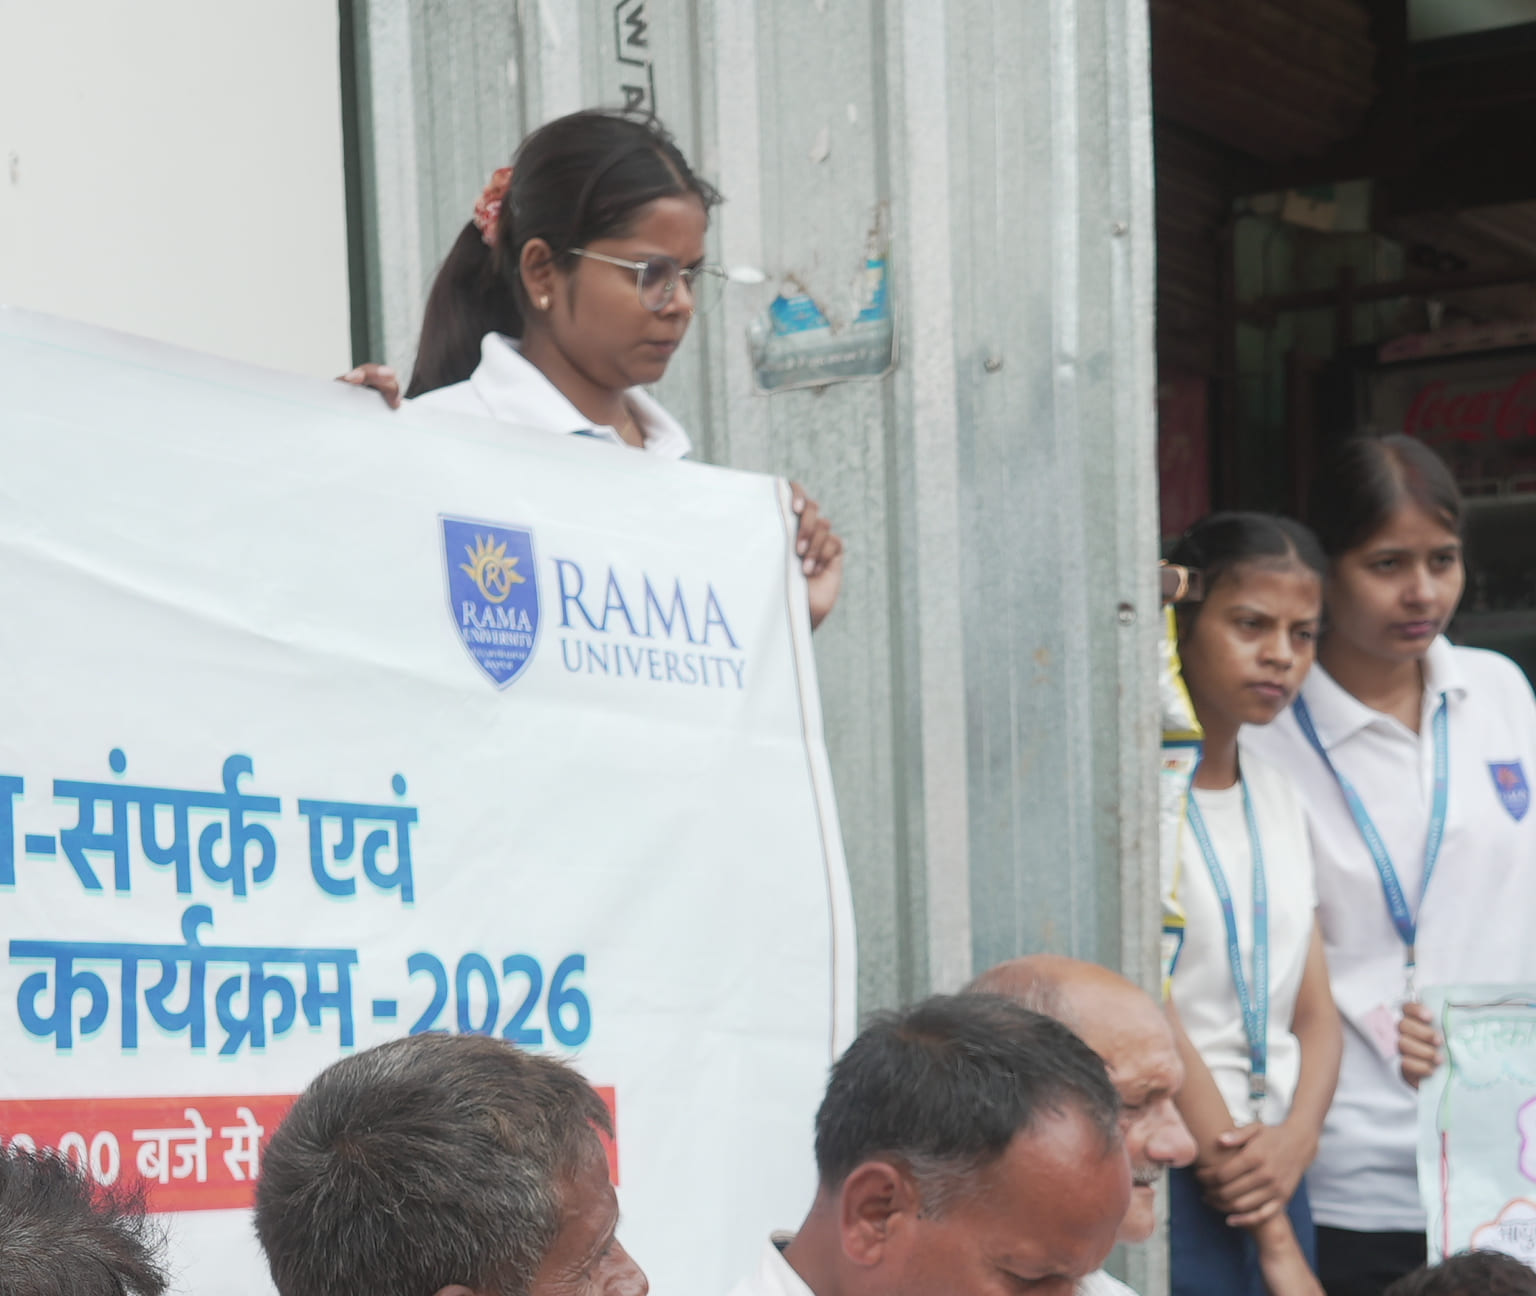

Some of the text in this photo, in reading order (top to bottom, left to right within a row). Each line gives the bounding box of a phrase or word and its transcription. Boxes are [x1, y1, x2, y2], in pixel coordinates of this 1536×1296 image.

[462, 600, 533, 632] RAMA
[551, 556, 744, 650] RAMA
[559, 637, 747, 690] UNIVERSITY
[298, 773, 419, 904] एवं
[133, 1110, 213, 1185] बजे
[221, 1107, 264, 1182] से
